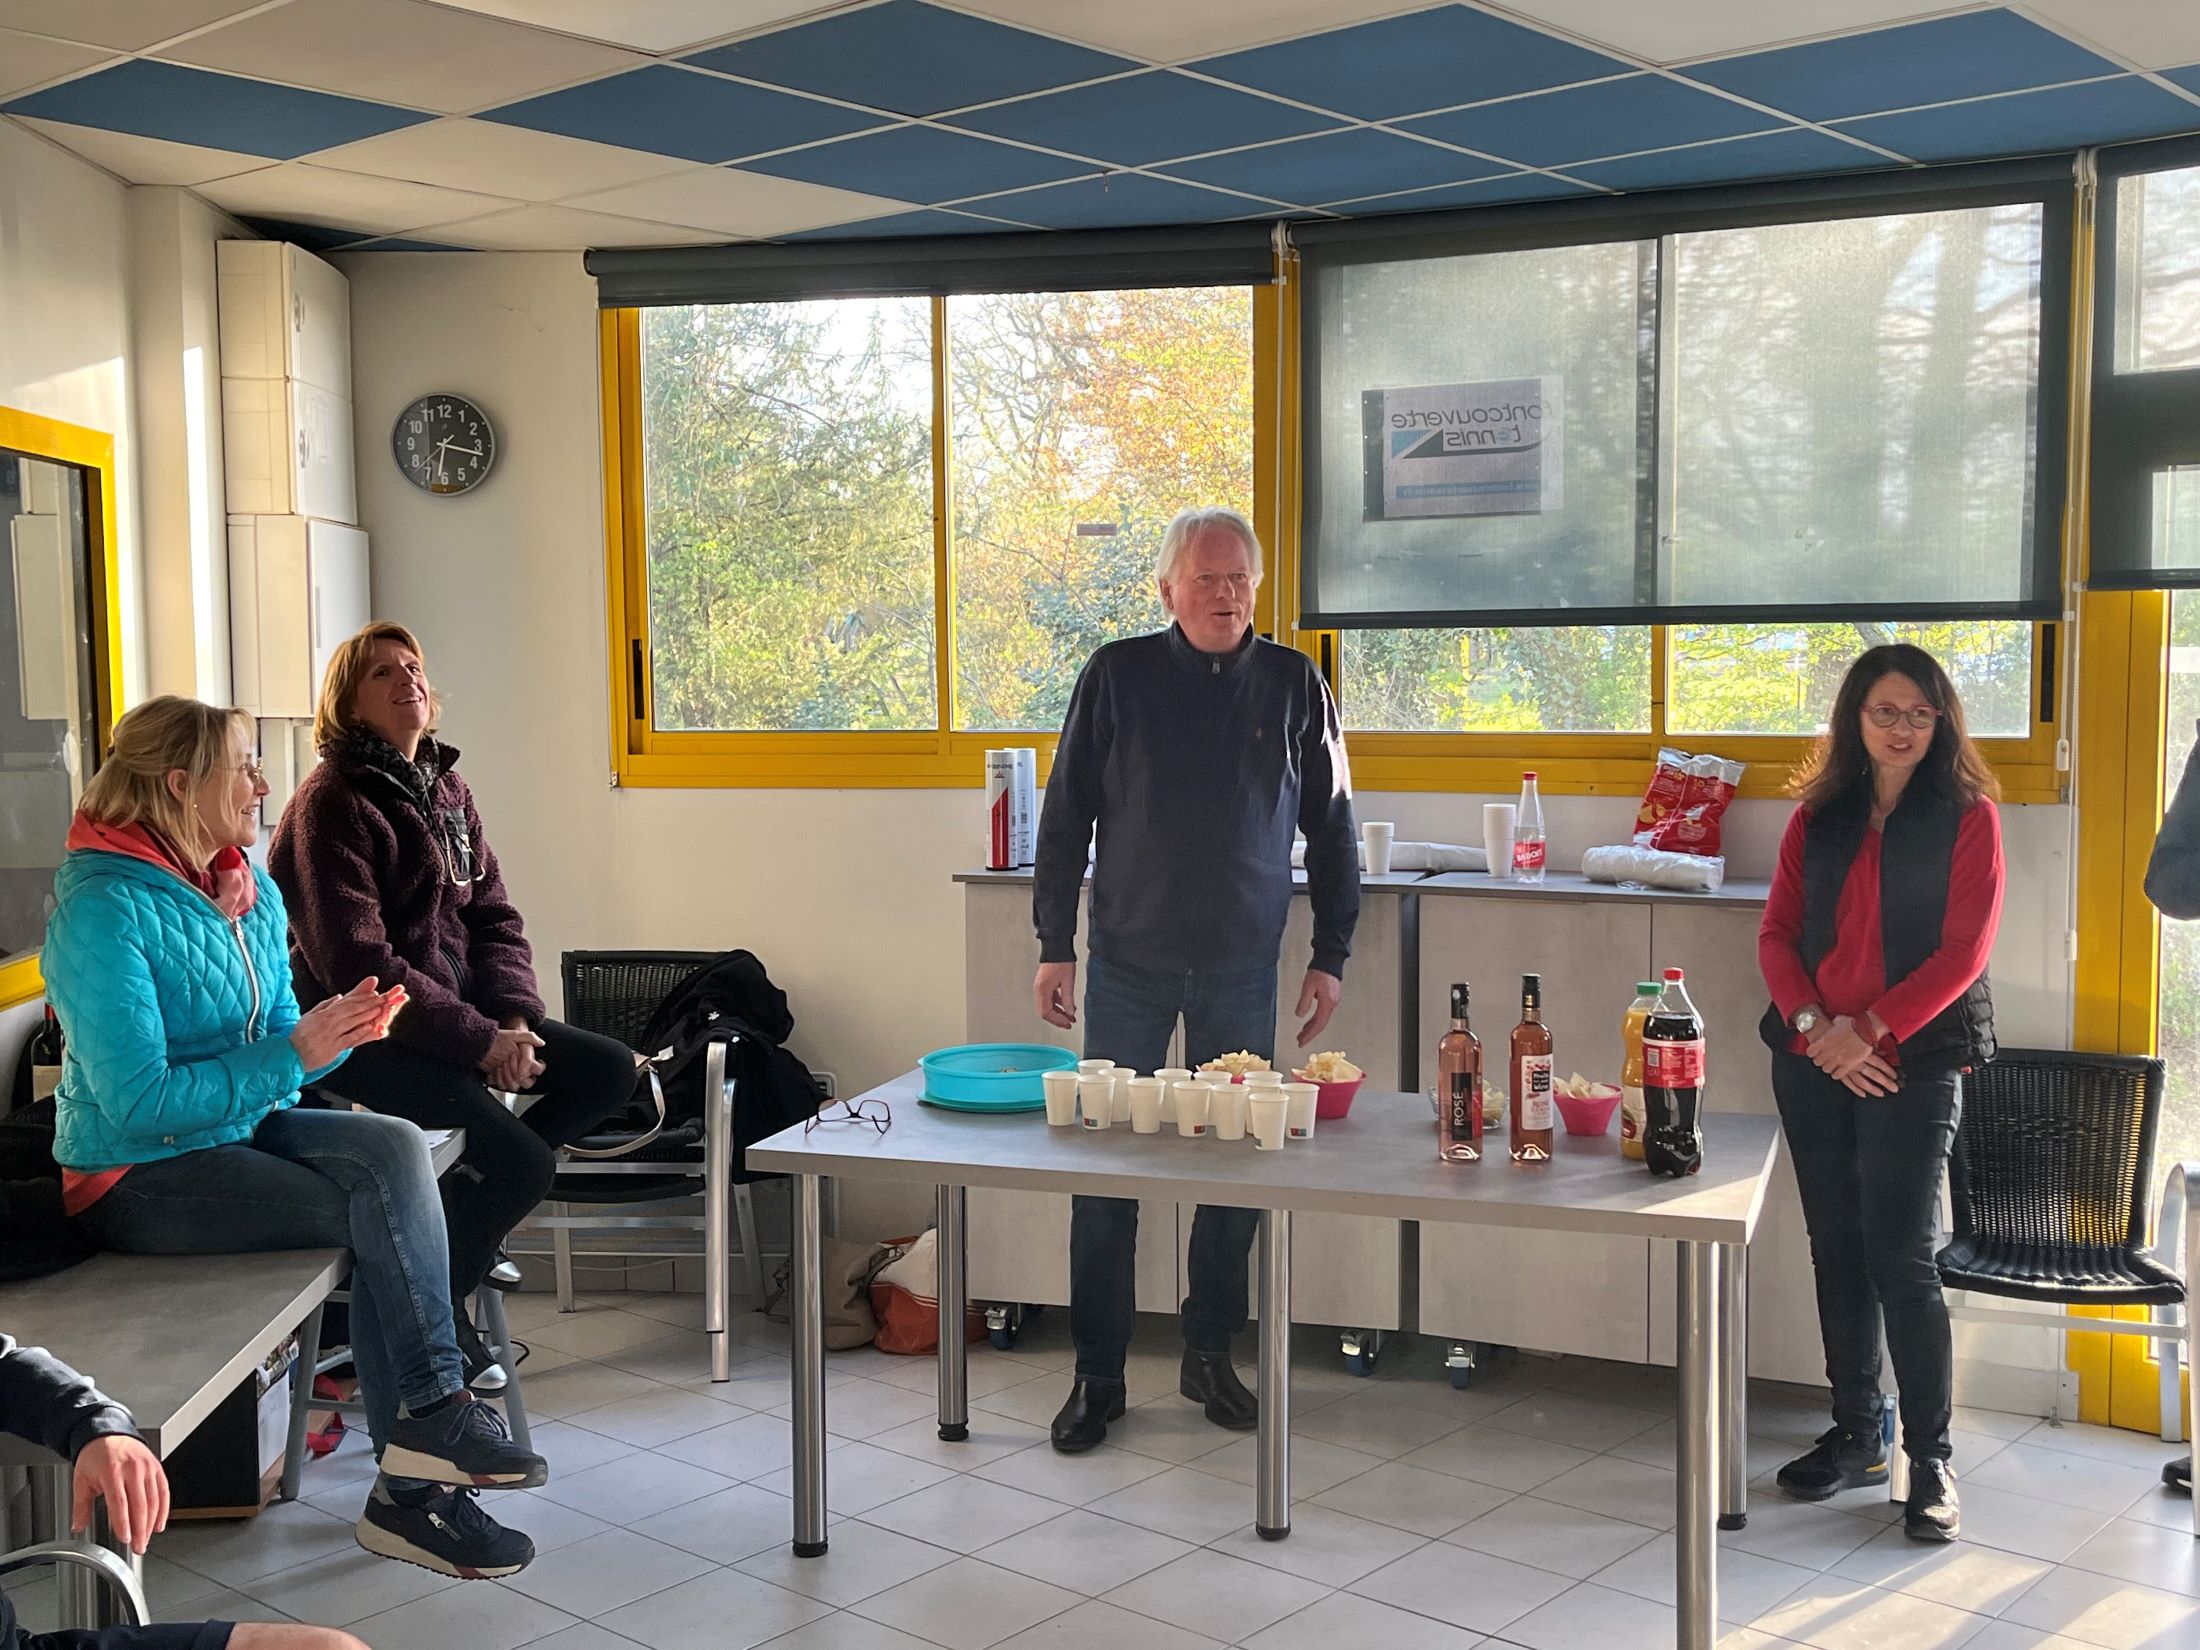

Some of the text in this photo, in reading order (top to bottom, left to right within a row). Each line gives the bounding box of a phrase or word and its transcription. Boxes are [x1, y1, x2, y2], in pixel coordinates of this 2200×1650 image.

[422, 409, 434, 422] 11
[437, 404, 452, 418] 12
[458, 409, 465, 423] 1
[408, 420, 423, 434] 10
[469, 422, 478, 436] 2
[407, 437, 415, 450] 9
[474, 439, 482, 453] 3
[411, 454, 420, 468] 8
[469, 456, 478, 469] 4
[424, 467, 431, 480] 7
[441, 472, 449, 485] 6
[457, 468, 466, 481] 5
[1451, 1091, 1464, 1126] ROSÉ
